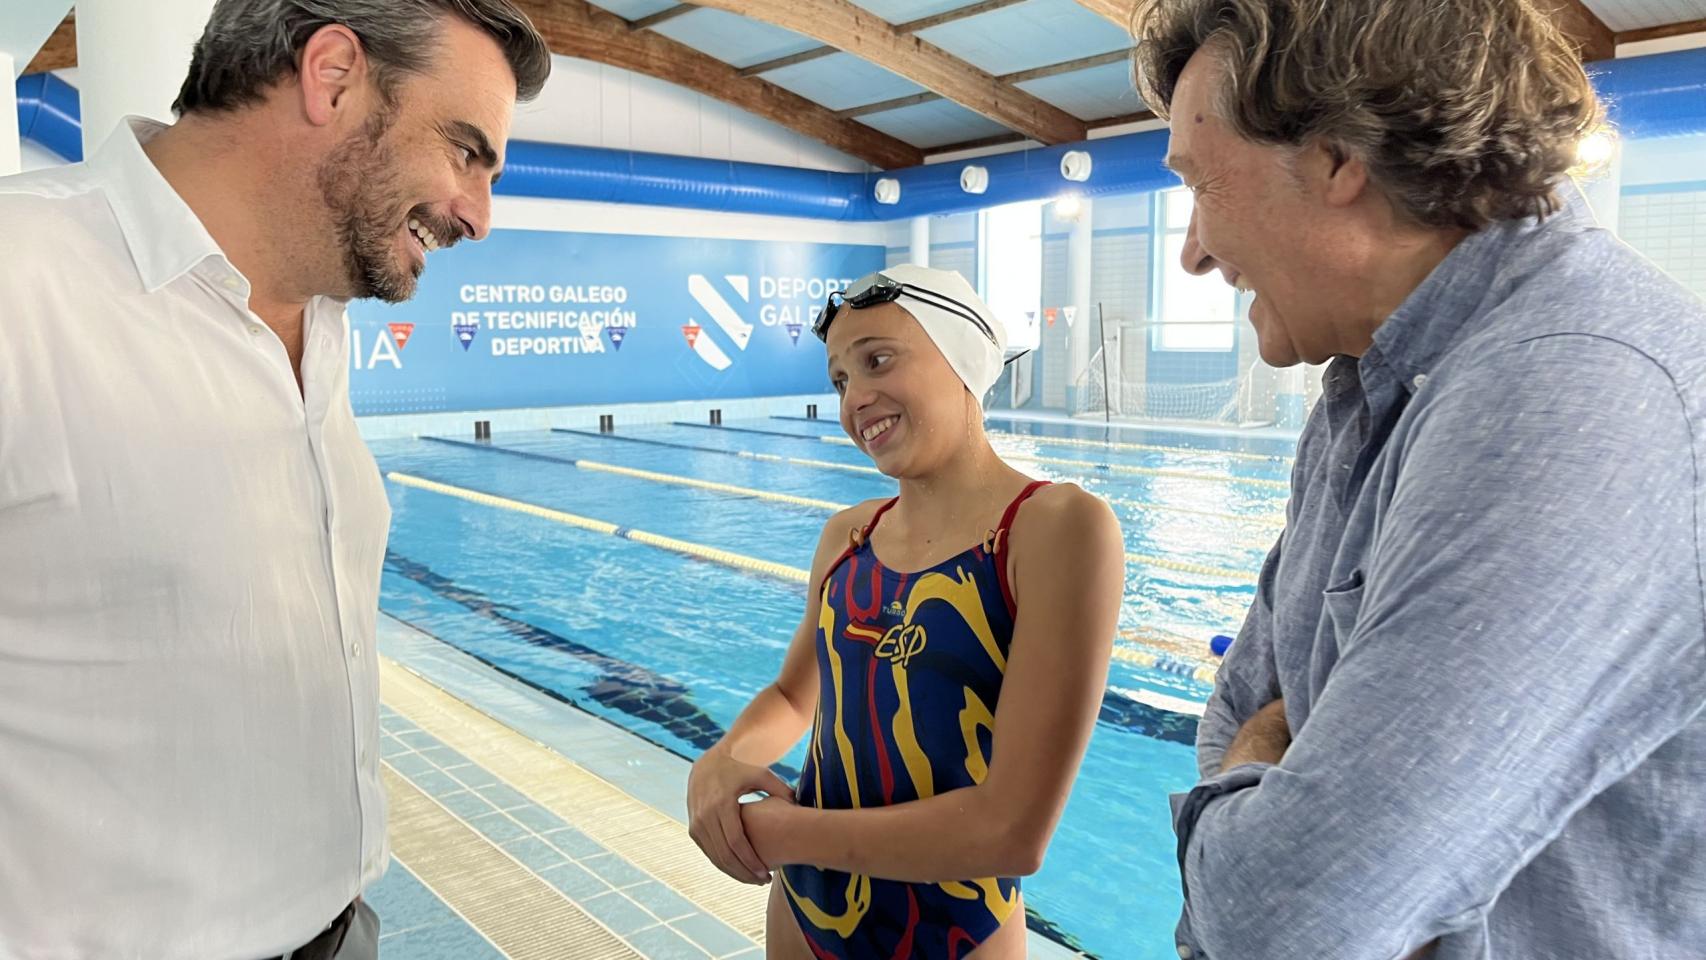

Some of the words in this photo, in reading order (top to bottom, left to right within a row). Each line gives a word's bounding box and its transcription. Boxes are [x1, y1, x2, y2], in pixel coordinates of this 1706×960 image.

[460, 284, 545, 303] CENTRO
[549, 285, 627, 303] GALEGO
[760, 276, 857, 299] DEPORT
[452, 312, 480, 329] DE
[484, 307, 636, 329] TECNIFICACIÓN
[491, 336, 605, 355] DEPORTIVA
[875, 624, 926, 667] ESP
